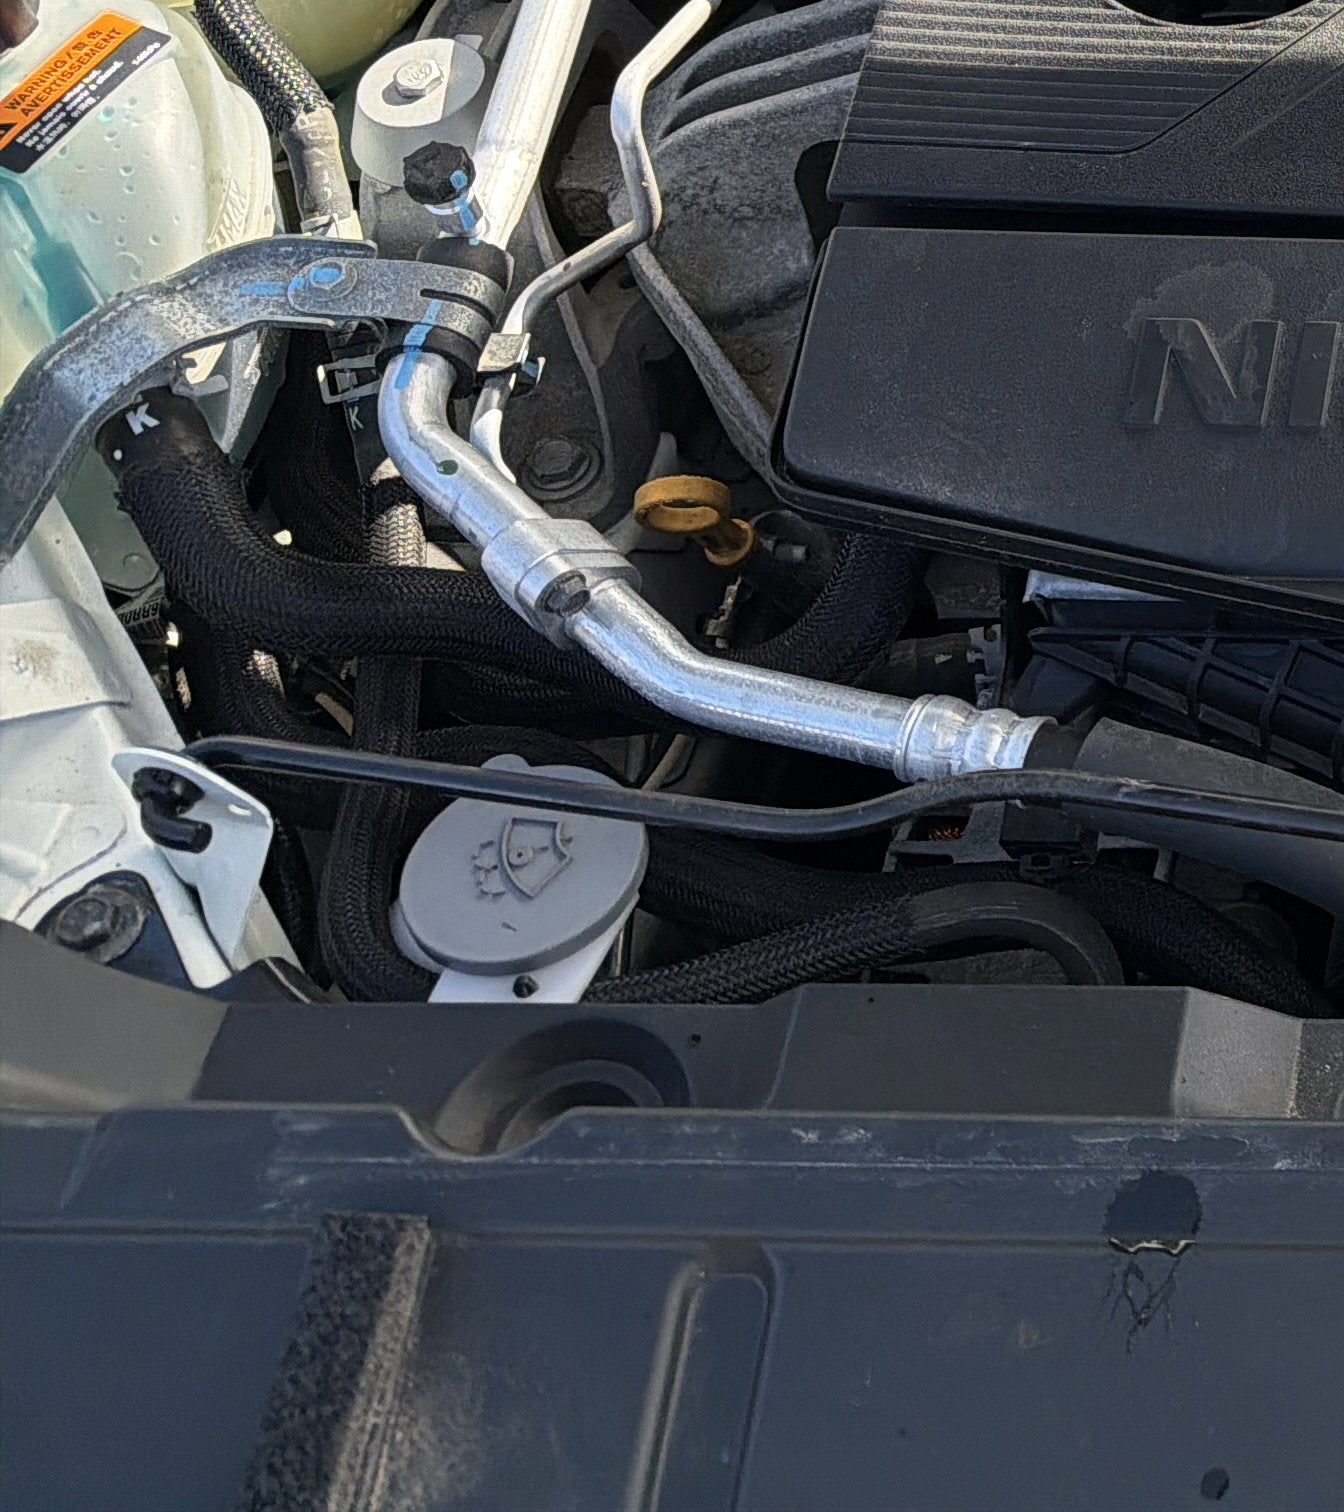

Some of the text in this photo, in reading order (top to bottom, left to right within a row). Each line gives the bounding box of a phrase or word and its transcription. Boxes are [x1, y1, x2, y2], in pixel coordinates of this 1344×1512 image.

[5, 58, 66, 110] WARNING
[20, 28, 122, 117] AVERTISSEMENT
[125, 403, 160, 435] K
[349, 406, 364, 430] K
